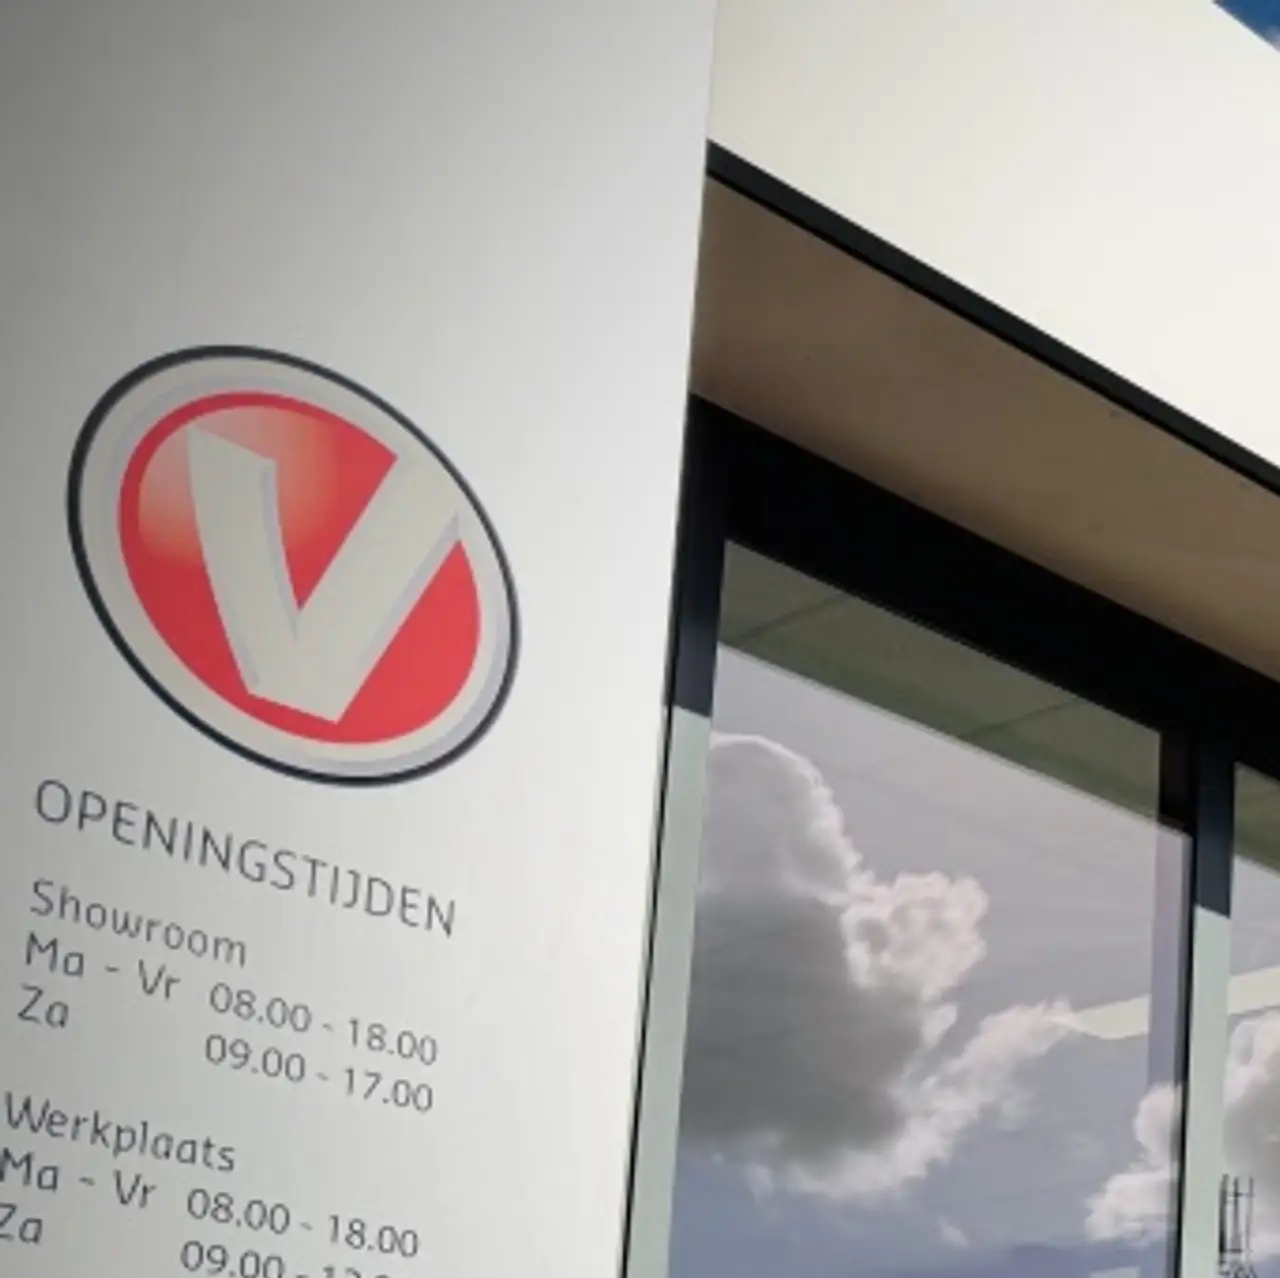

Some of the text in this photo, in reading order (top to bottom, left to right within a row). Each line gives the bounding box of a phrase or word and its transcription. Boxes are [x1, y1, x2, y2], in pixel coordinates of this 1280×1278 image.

[34, 779, 457, 938] OPENINGSTIJDEN
[30, 878, 247, 968] Showroom
[17, 984, 70, 1029] Za
[204, 1033, 306, 1083] 09.00
[343, 1068, 434, 1113] 17.00
[24, 932, 85, 978] Ma
[138, 960, 181, 1001] Vr
[209, 982, 312, 1034] 08.00
[347, 1018, 439, 1065] 18.00
[4, 1091, 236, 1172] Werkplaats
[0, 1147, 59, 1194] Ma
[114, 1169, 157, 1209] Vr
[187, 1188, 291, 1235] 08.00
[327, 1214, 419, 1258] 18.00
[0, 1203, 44, 1246] Za
